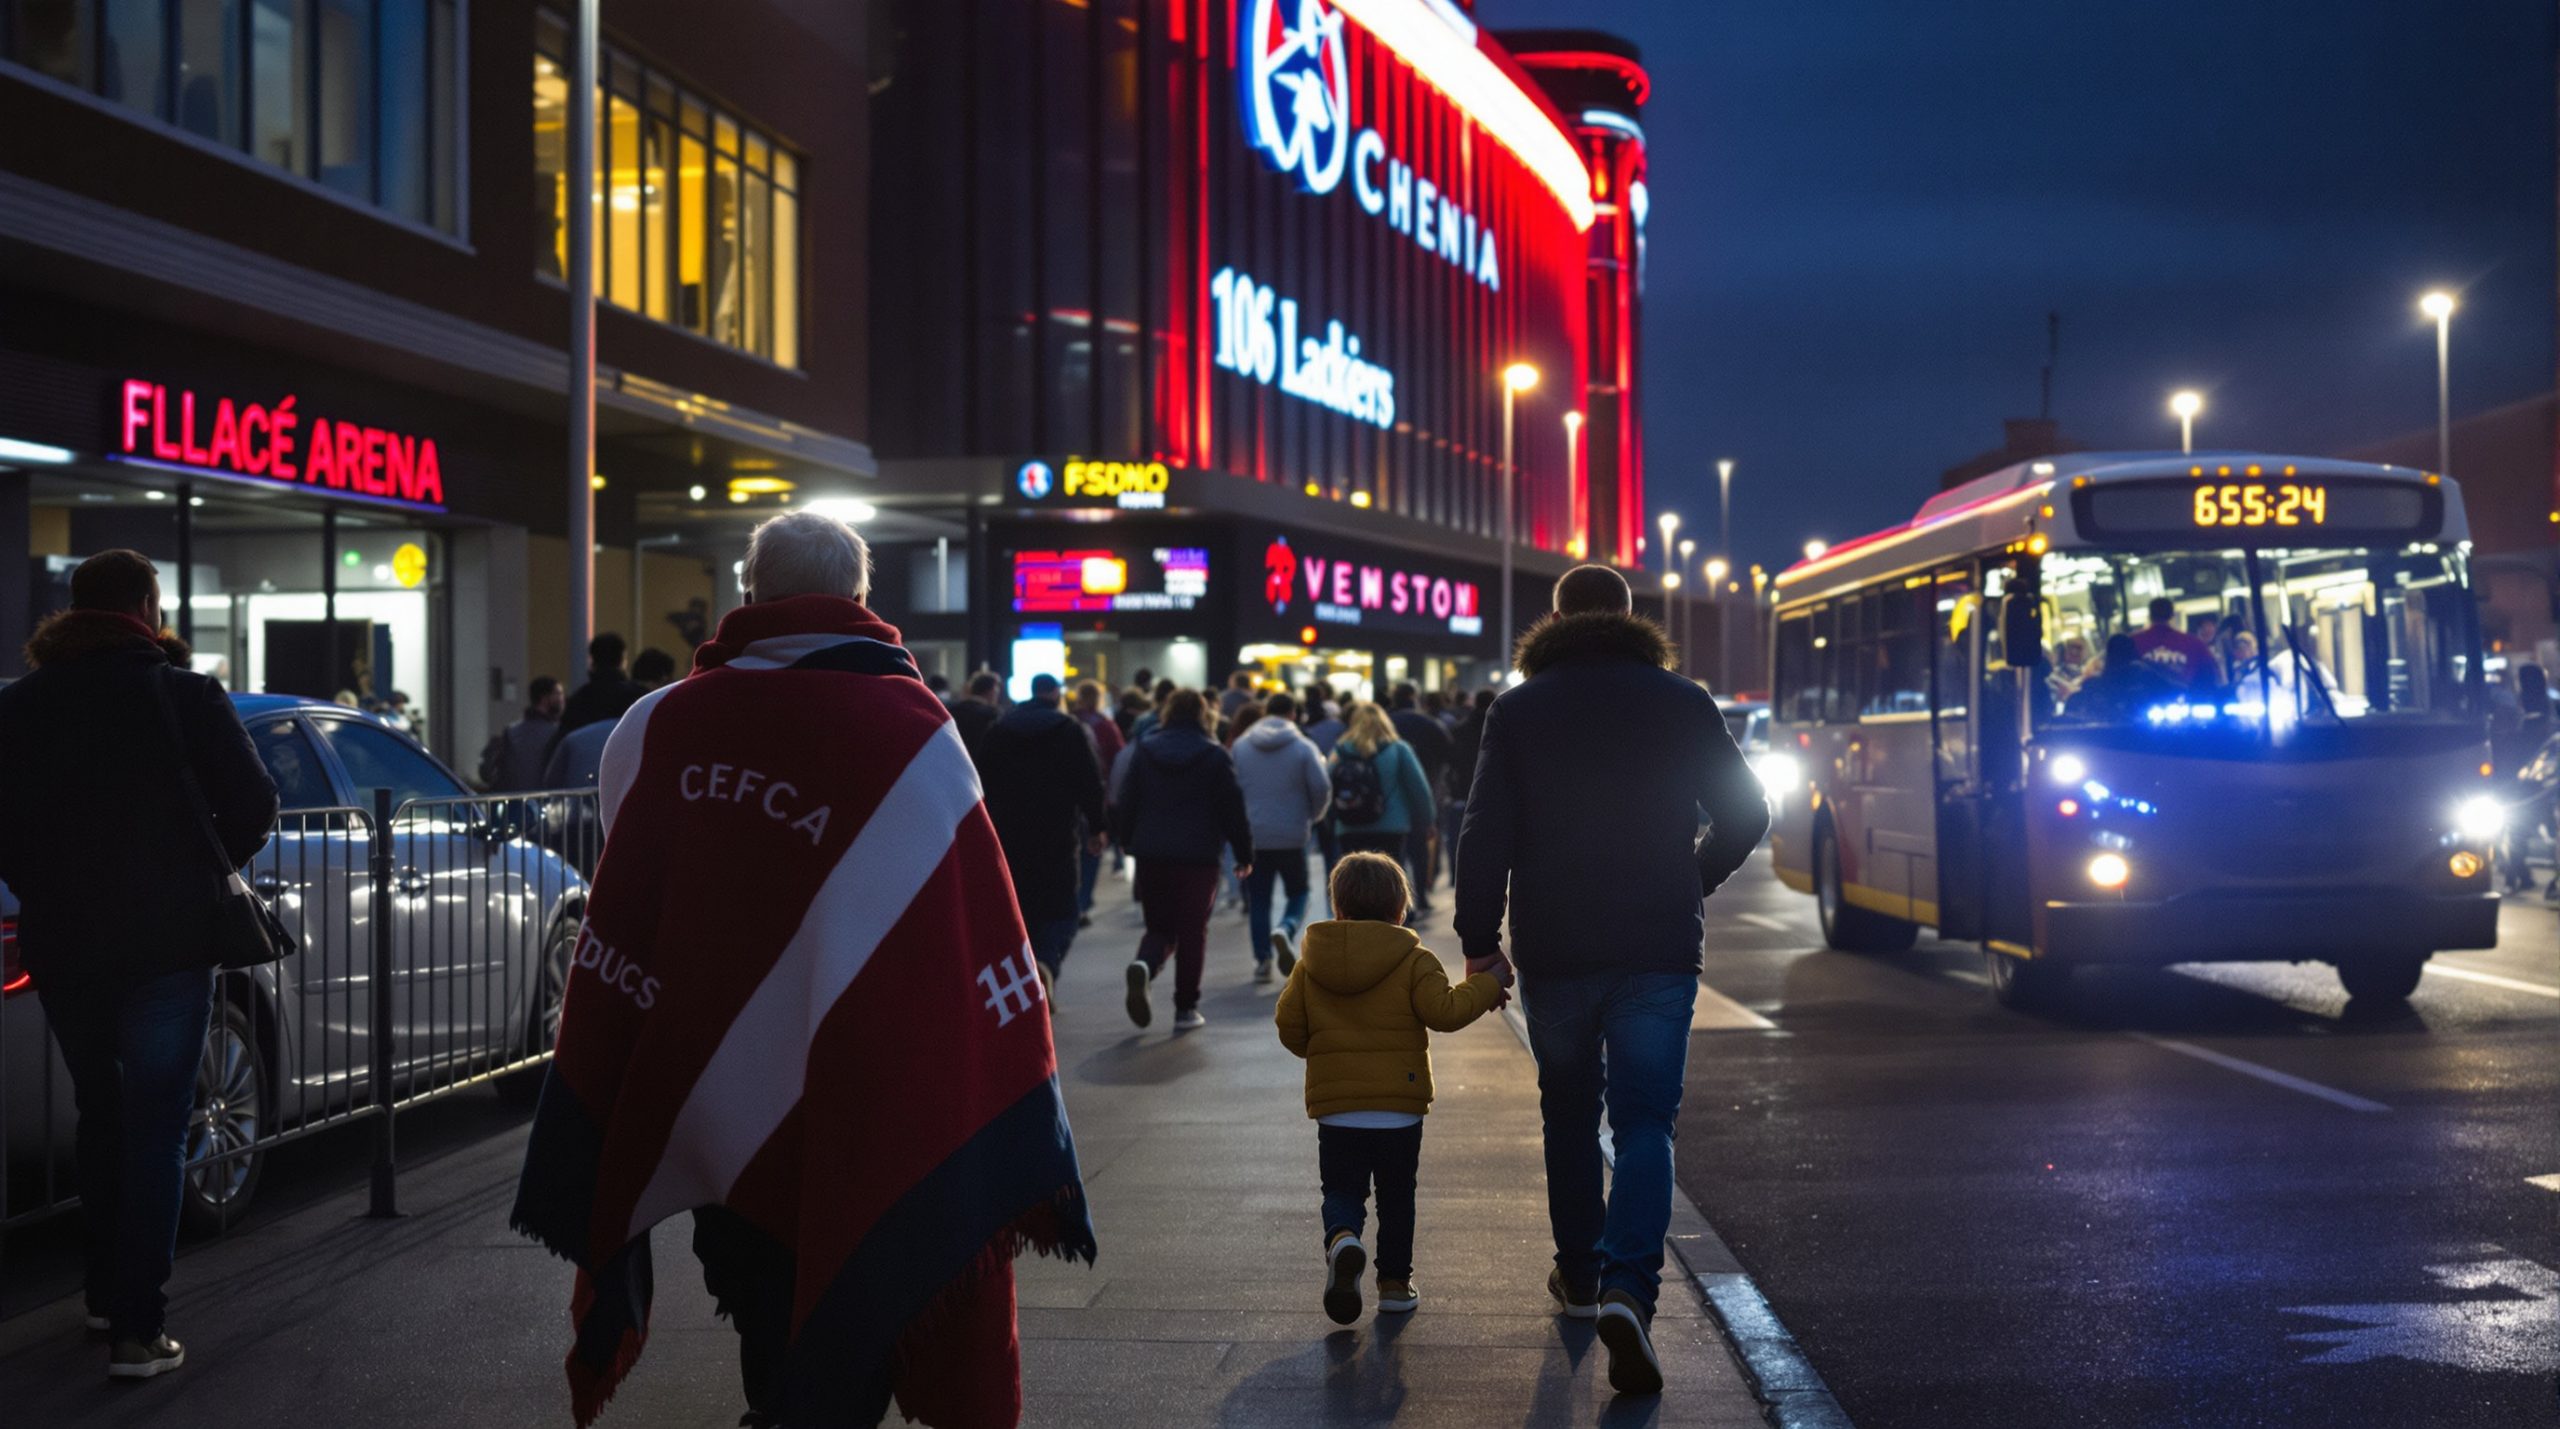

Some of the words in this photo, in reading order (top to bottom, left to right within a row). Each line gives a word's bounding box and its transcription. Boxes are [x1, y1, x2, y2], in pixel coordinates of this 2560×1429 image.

[1354, 129, 1500, 292] CHENIA
[1211, 266, 1277, 385] 106
[122, 378, 297, 480] FLLACÉ
[304, 417, 443, 504] ARENA
[2194, 484, 2326, 526] 655:24
[680, 763, 832, 846] CEFCA
[574, 917, 661, 1010] DUCS
